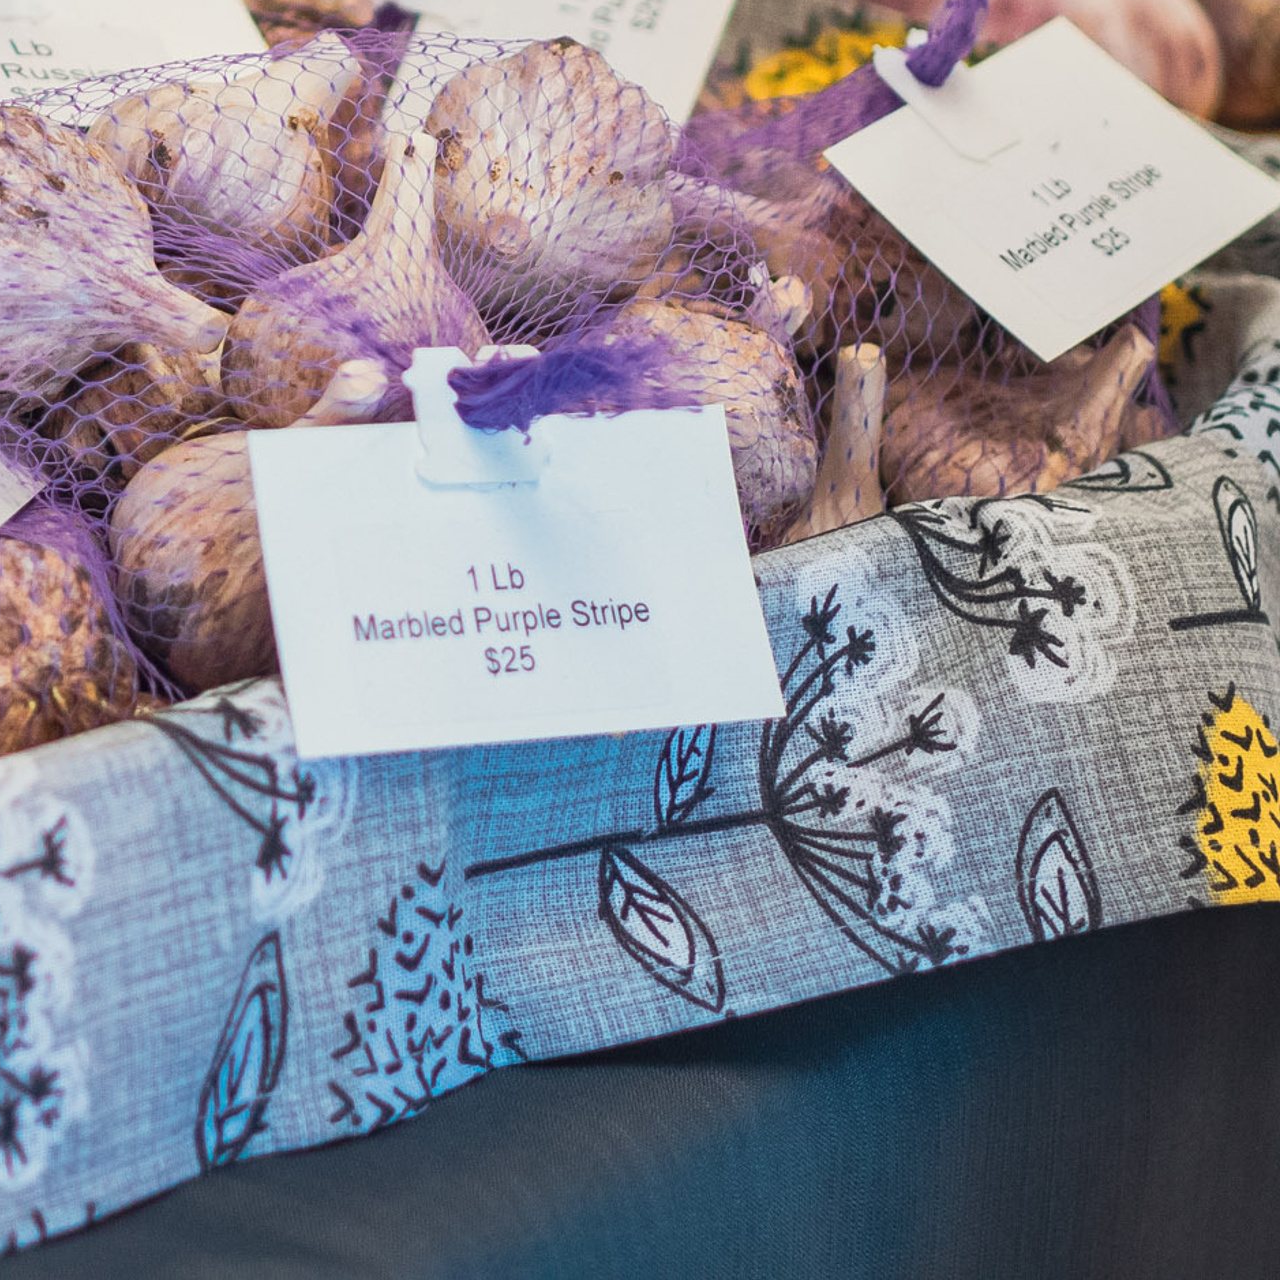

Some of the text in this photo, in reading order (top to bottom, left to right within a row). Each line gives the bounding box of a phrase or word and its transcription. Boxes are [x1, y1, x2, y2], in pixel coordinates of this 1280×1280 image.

[9, 38, 53, 57] Lb
[1032, 177, 1072, 206] 1 Lb
[999, 164, 1162, 271] Marbled Purple Stripe
[1091, 226, 1131, 257] $25
[467, 563, 524, 592] 1 Lb
[352, 597, 650, 642] Marbled Purple Stripe
[484, 645, 536, 676] $25
